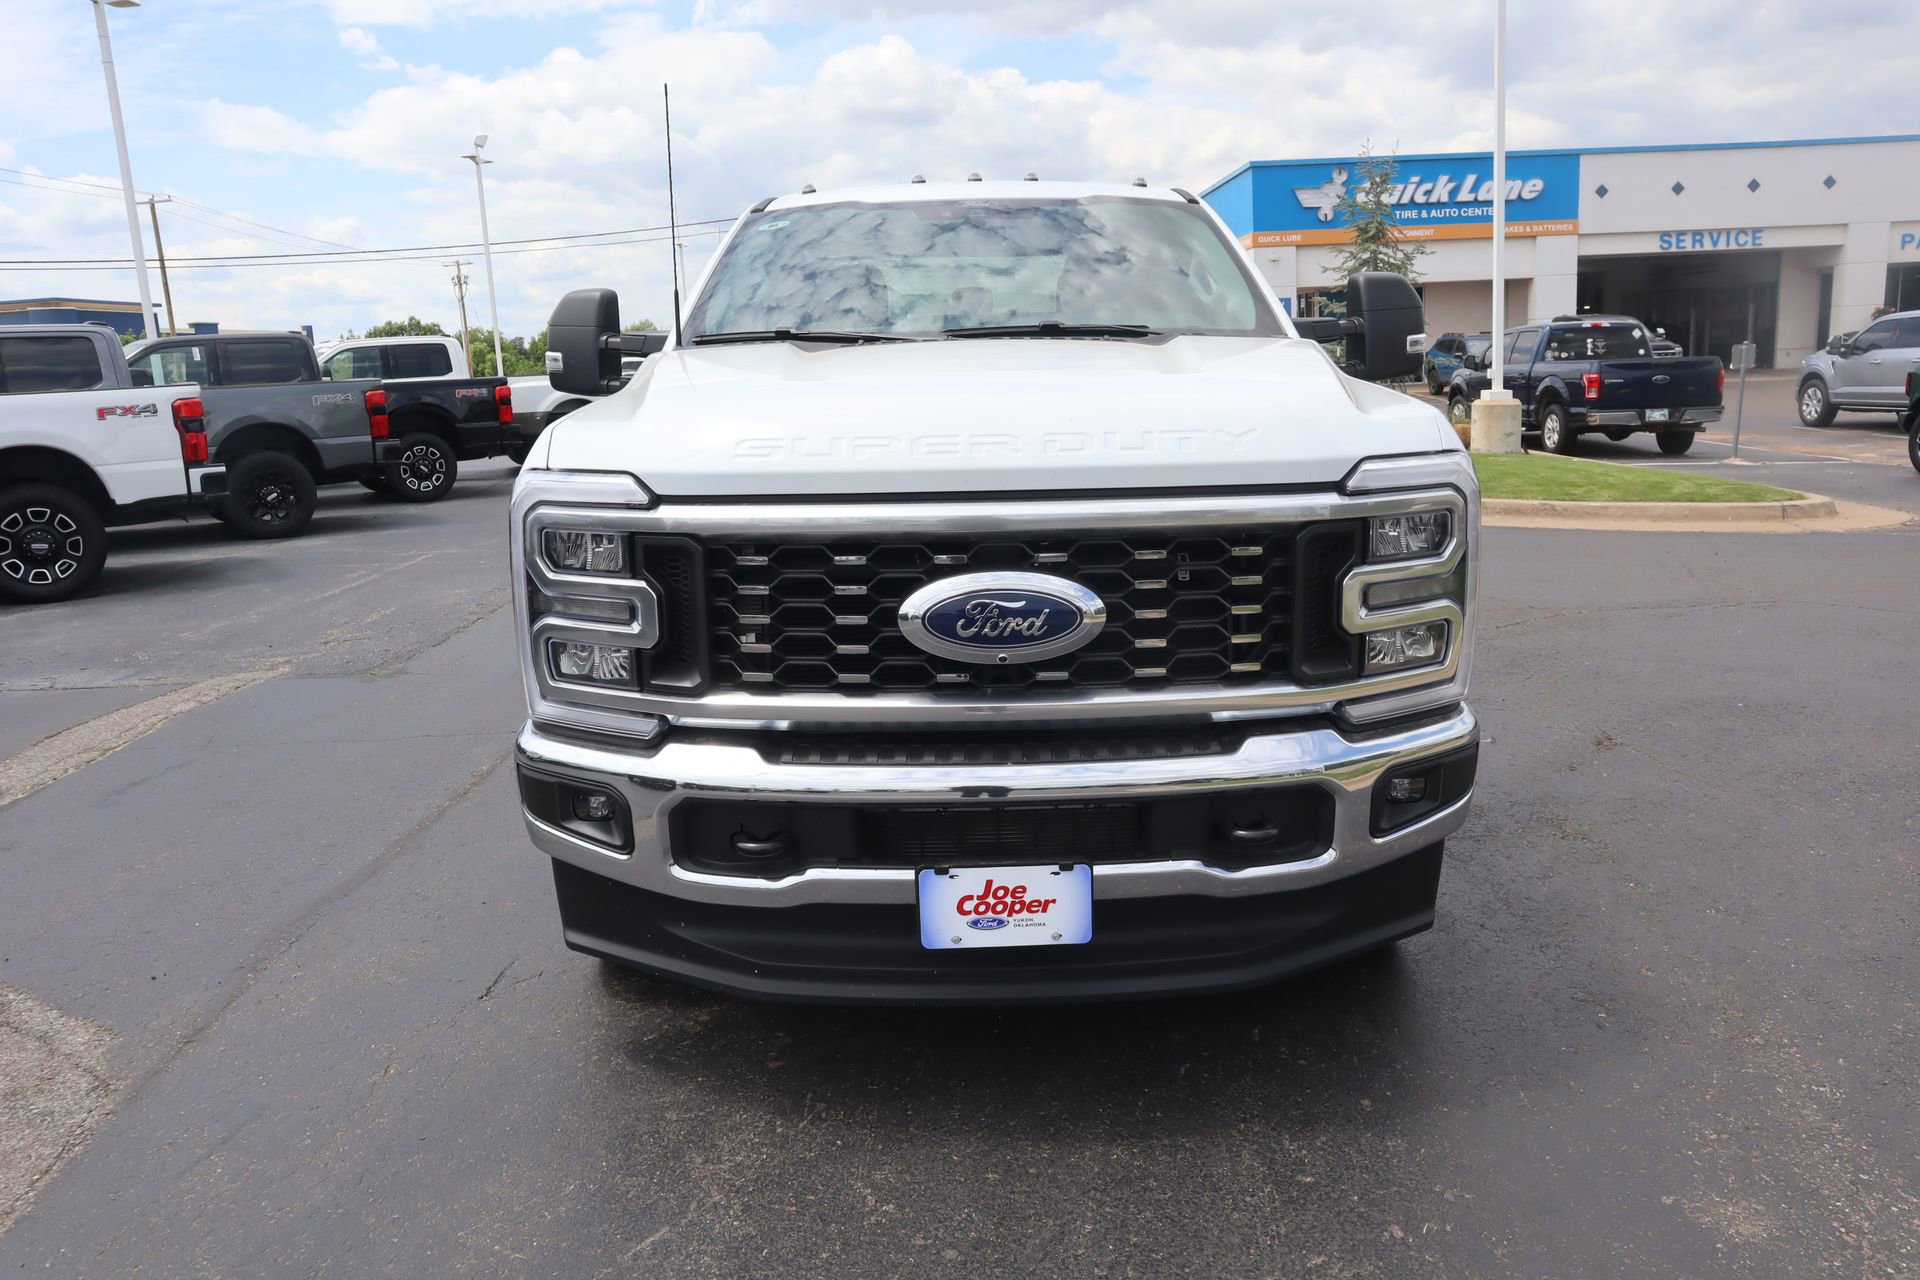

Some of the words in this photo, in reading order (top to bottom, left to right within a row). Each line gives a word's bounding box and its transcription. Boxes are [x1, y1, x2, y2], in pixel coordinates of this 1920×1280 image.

[1456, 174, 1544, 202] Lane
[1395, 210, 1418, 219] TIRE
[1421, 209, 1428, 218] &
[1430, 208, 1458, 218] AUTO
[1461, 207, 1494, 217] CENTE
[1505, 225, 1524, 233] AKES
[1533, 223, 1573, 232] BATTERIES
[1258, 235, 1281, 243] QUICK
[1282, 234, 1302, 242] LUBE
[1659, 229, 1764, 251] SERVICE
[312, 392, 356, 406] FX4
[455, 387, 488, 399] FX4
[96, 403, 159, 421] FX4
[733, 434, 1023, 460] SUPER
[1043, 428, 1260, 453] DUTY
[956, 599, 1050, 638] Ford
[976, 879, 1028, 902] Joe
[956, 894, 1057, 918] Cooper
[977, 918, 999, 928] Ford
